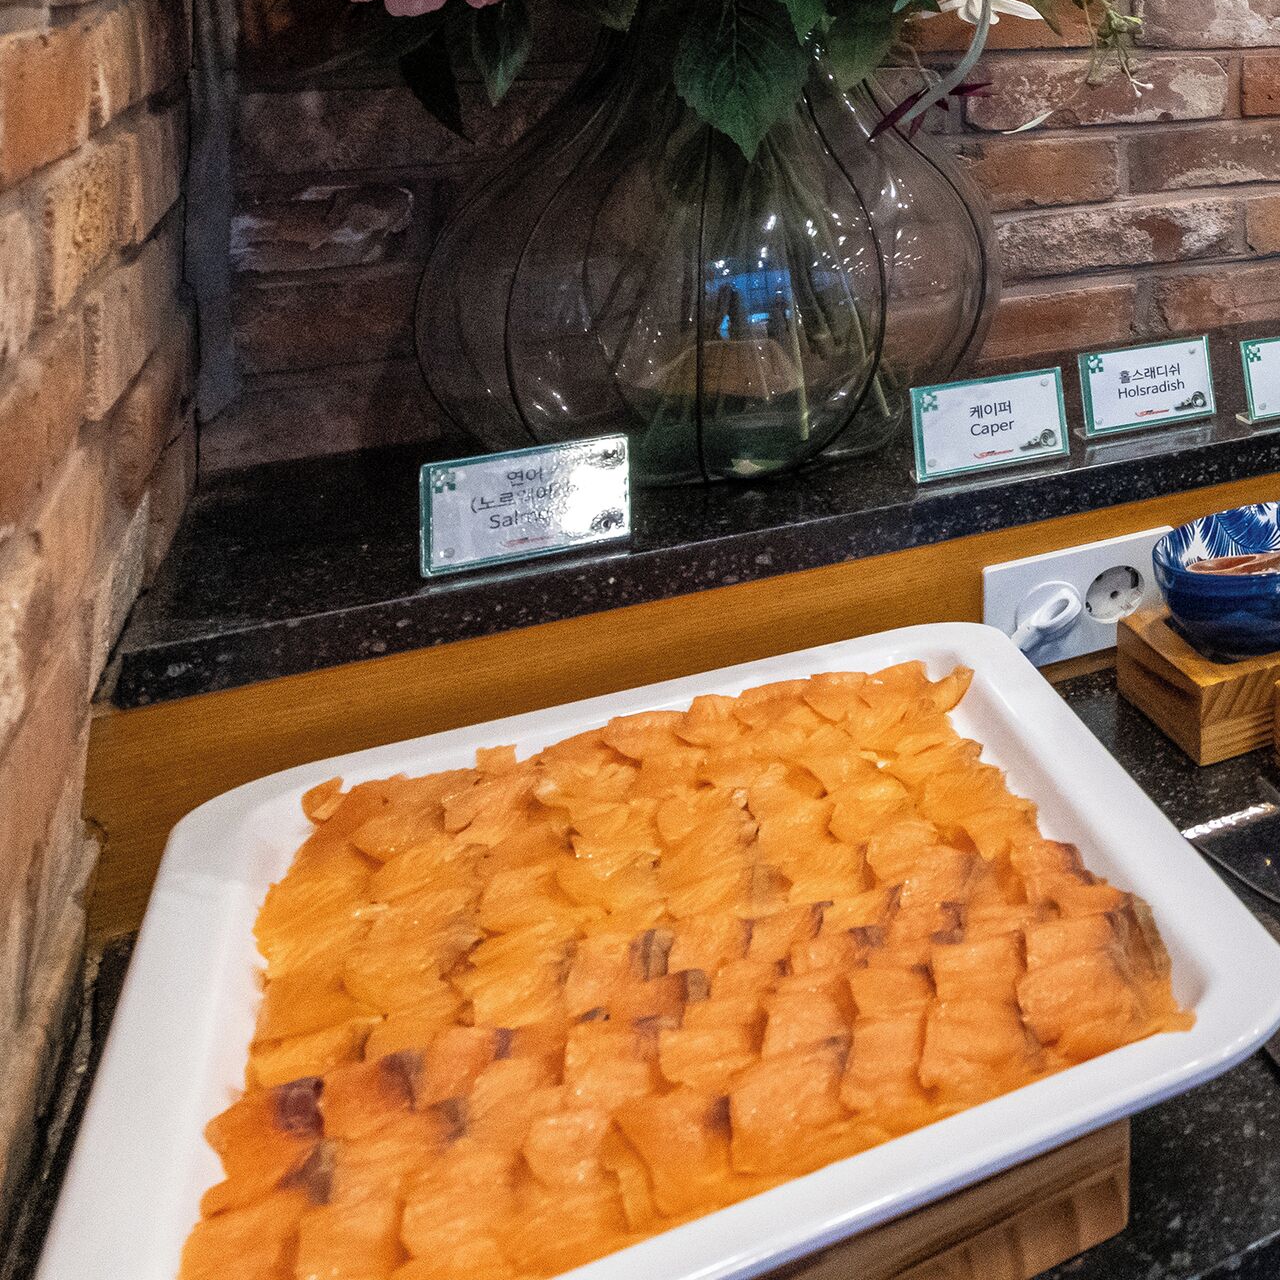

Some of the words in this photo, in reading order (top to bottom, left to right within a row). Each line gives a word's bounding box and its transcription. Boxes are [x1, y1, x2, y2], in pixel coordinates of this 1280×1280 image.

[1119, 362, 1181, 384] 홀스래디쉬
[1118, 379, 1185, 399] Holsradish
[969, 400, 1013, 419] 케이퍼
[970, 420, 1015, 436] Caper
[507, 467, 543, 487] 연어
